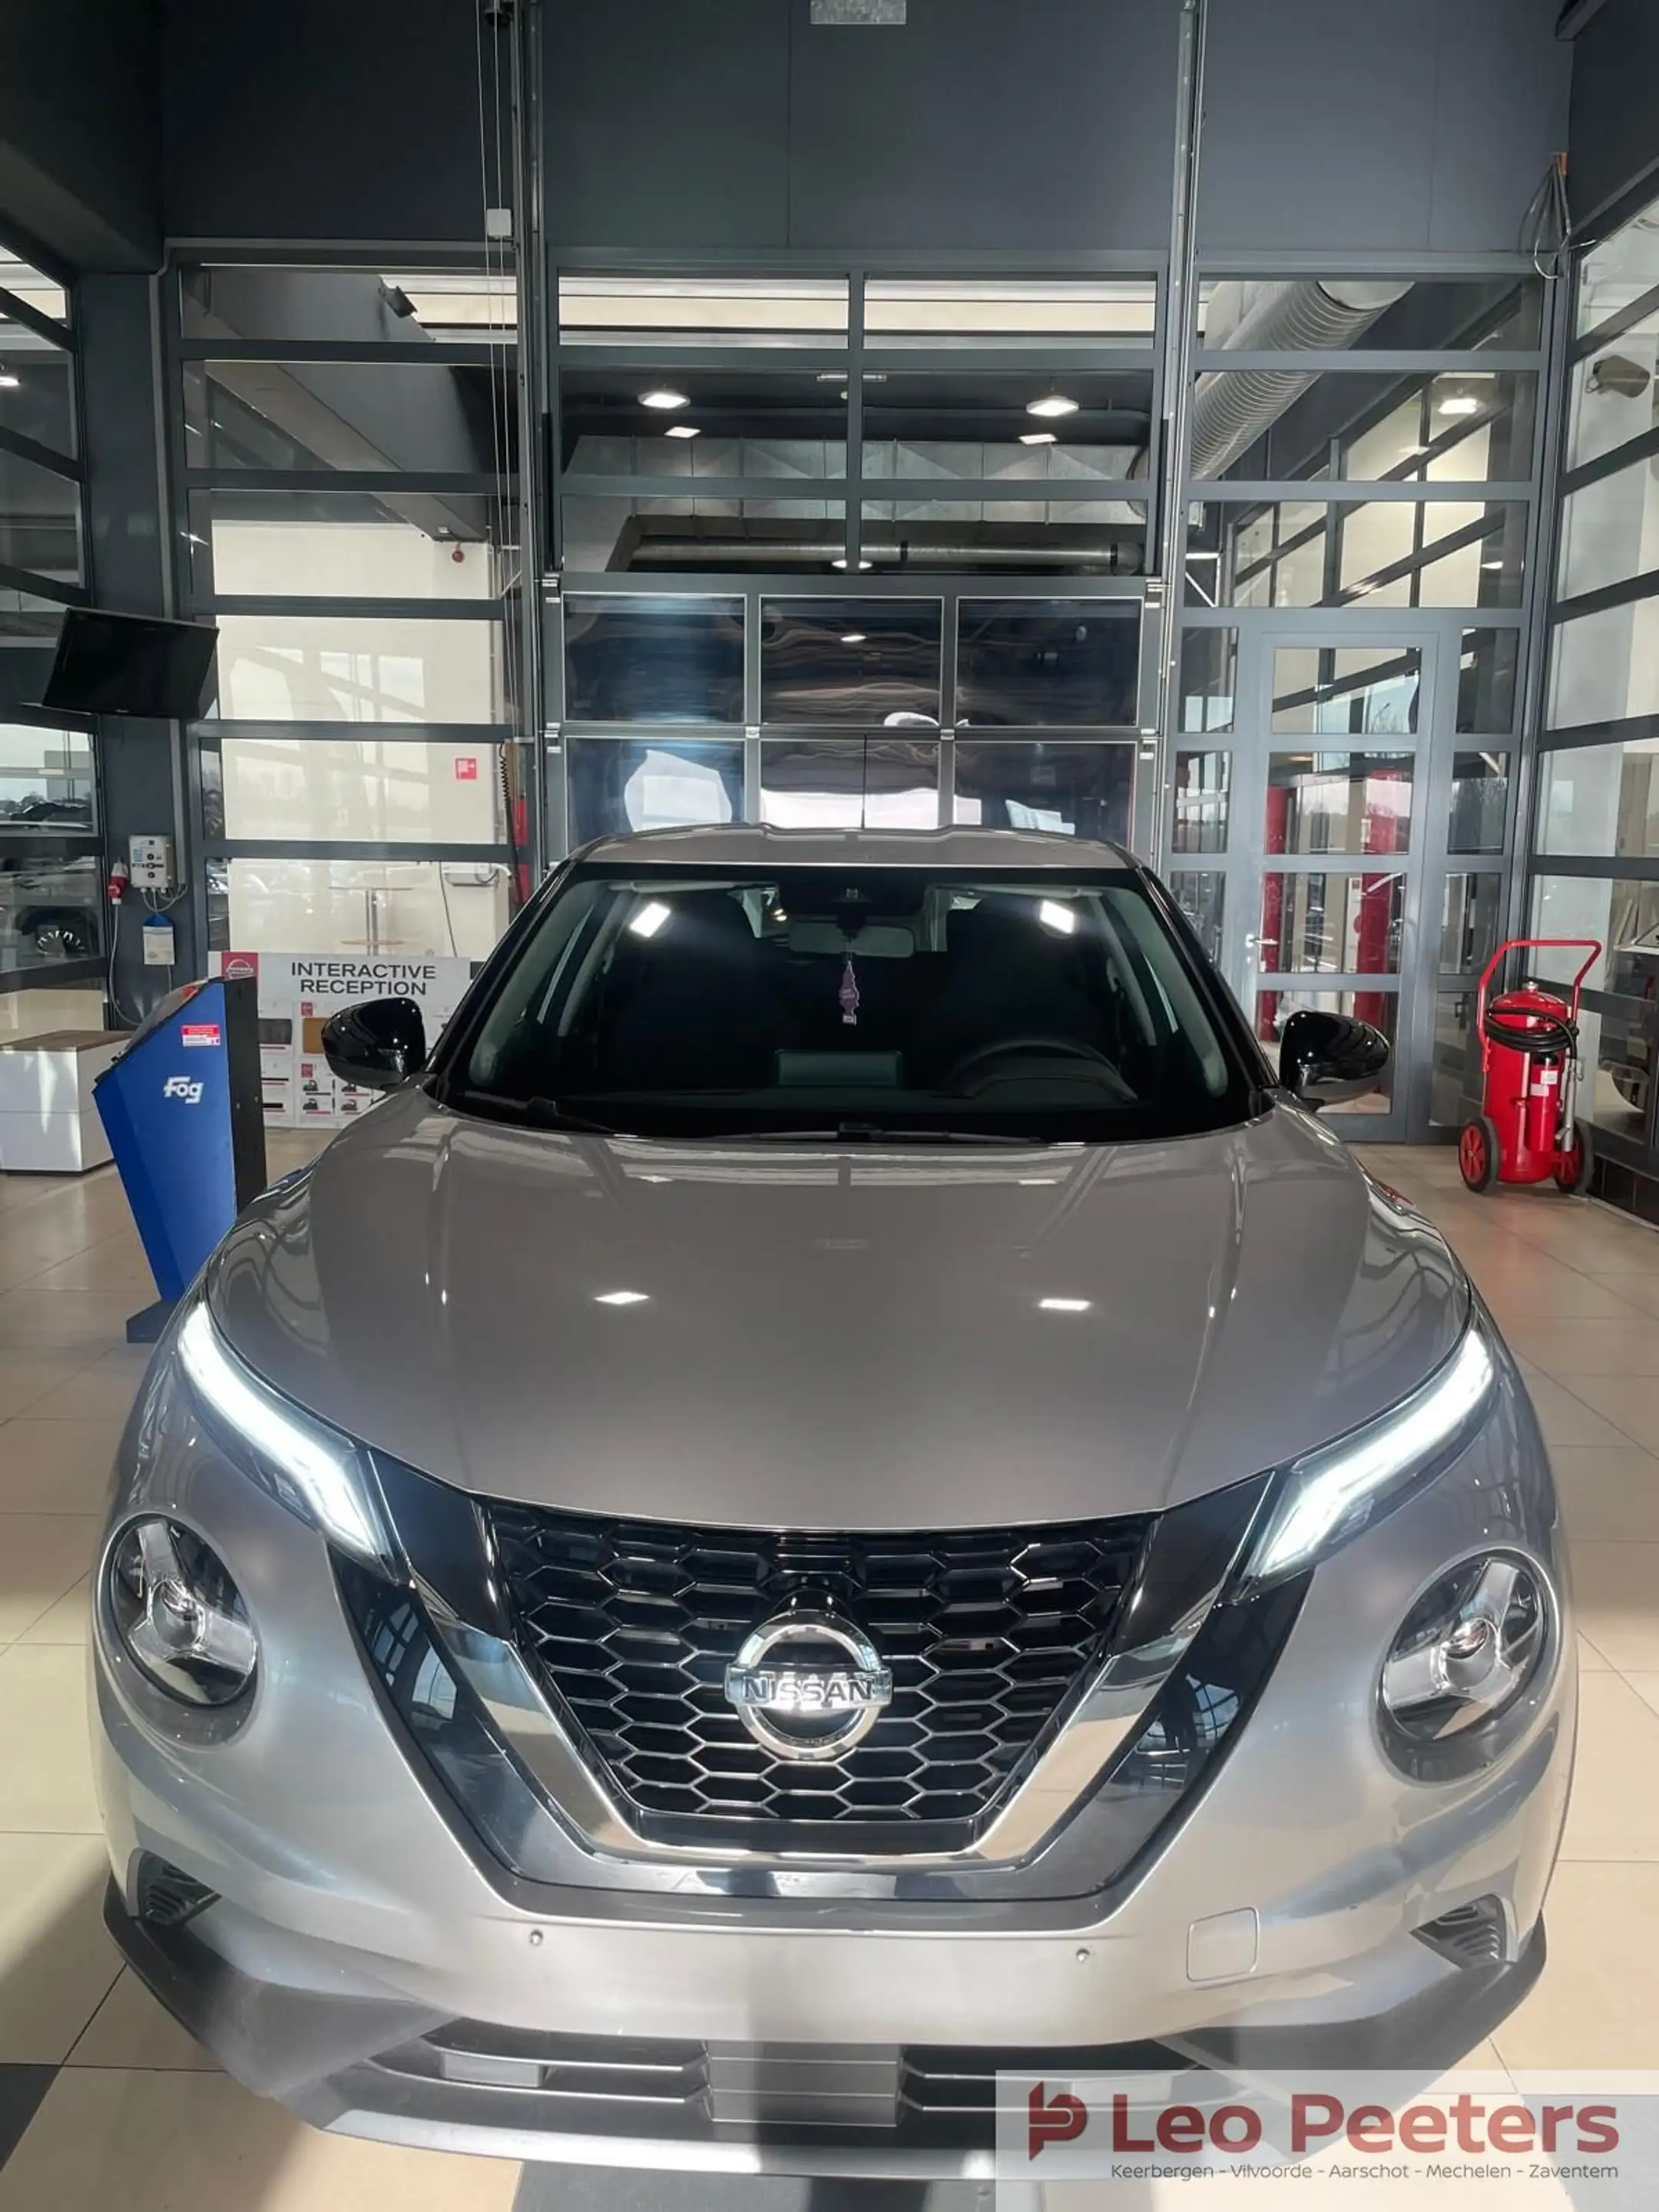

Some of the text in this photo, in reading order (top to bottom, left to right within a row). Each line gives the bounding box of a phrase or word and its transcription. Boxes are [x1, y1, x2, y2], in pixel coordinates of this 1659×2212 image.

[291, 962, 435, 979] INTERACTIVE
[300, 979, 426, 996] RECEPTION
[163, 1076, 204, 1104] Fog
[744, 1675, 873, 1701] NISSAN
